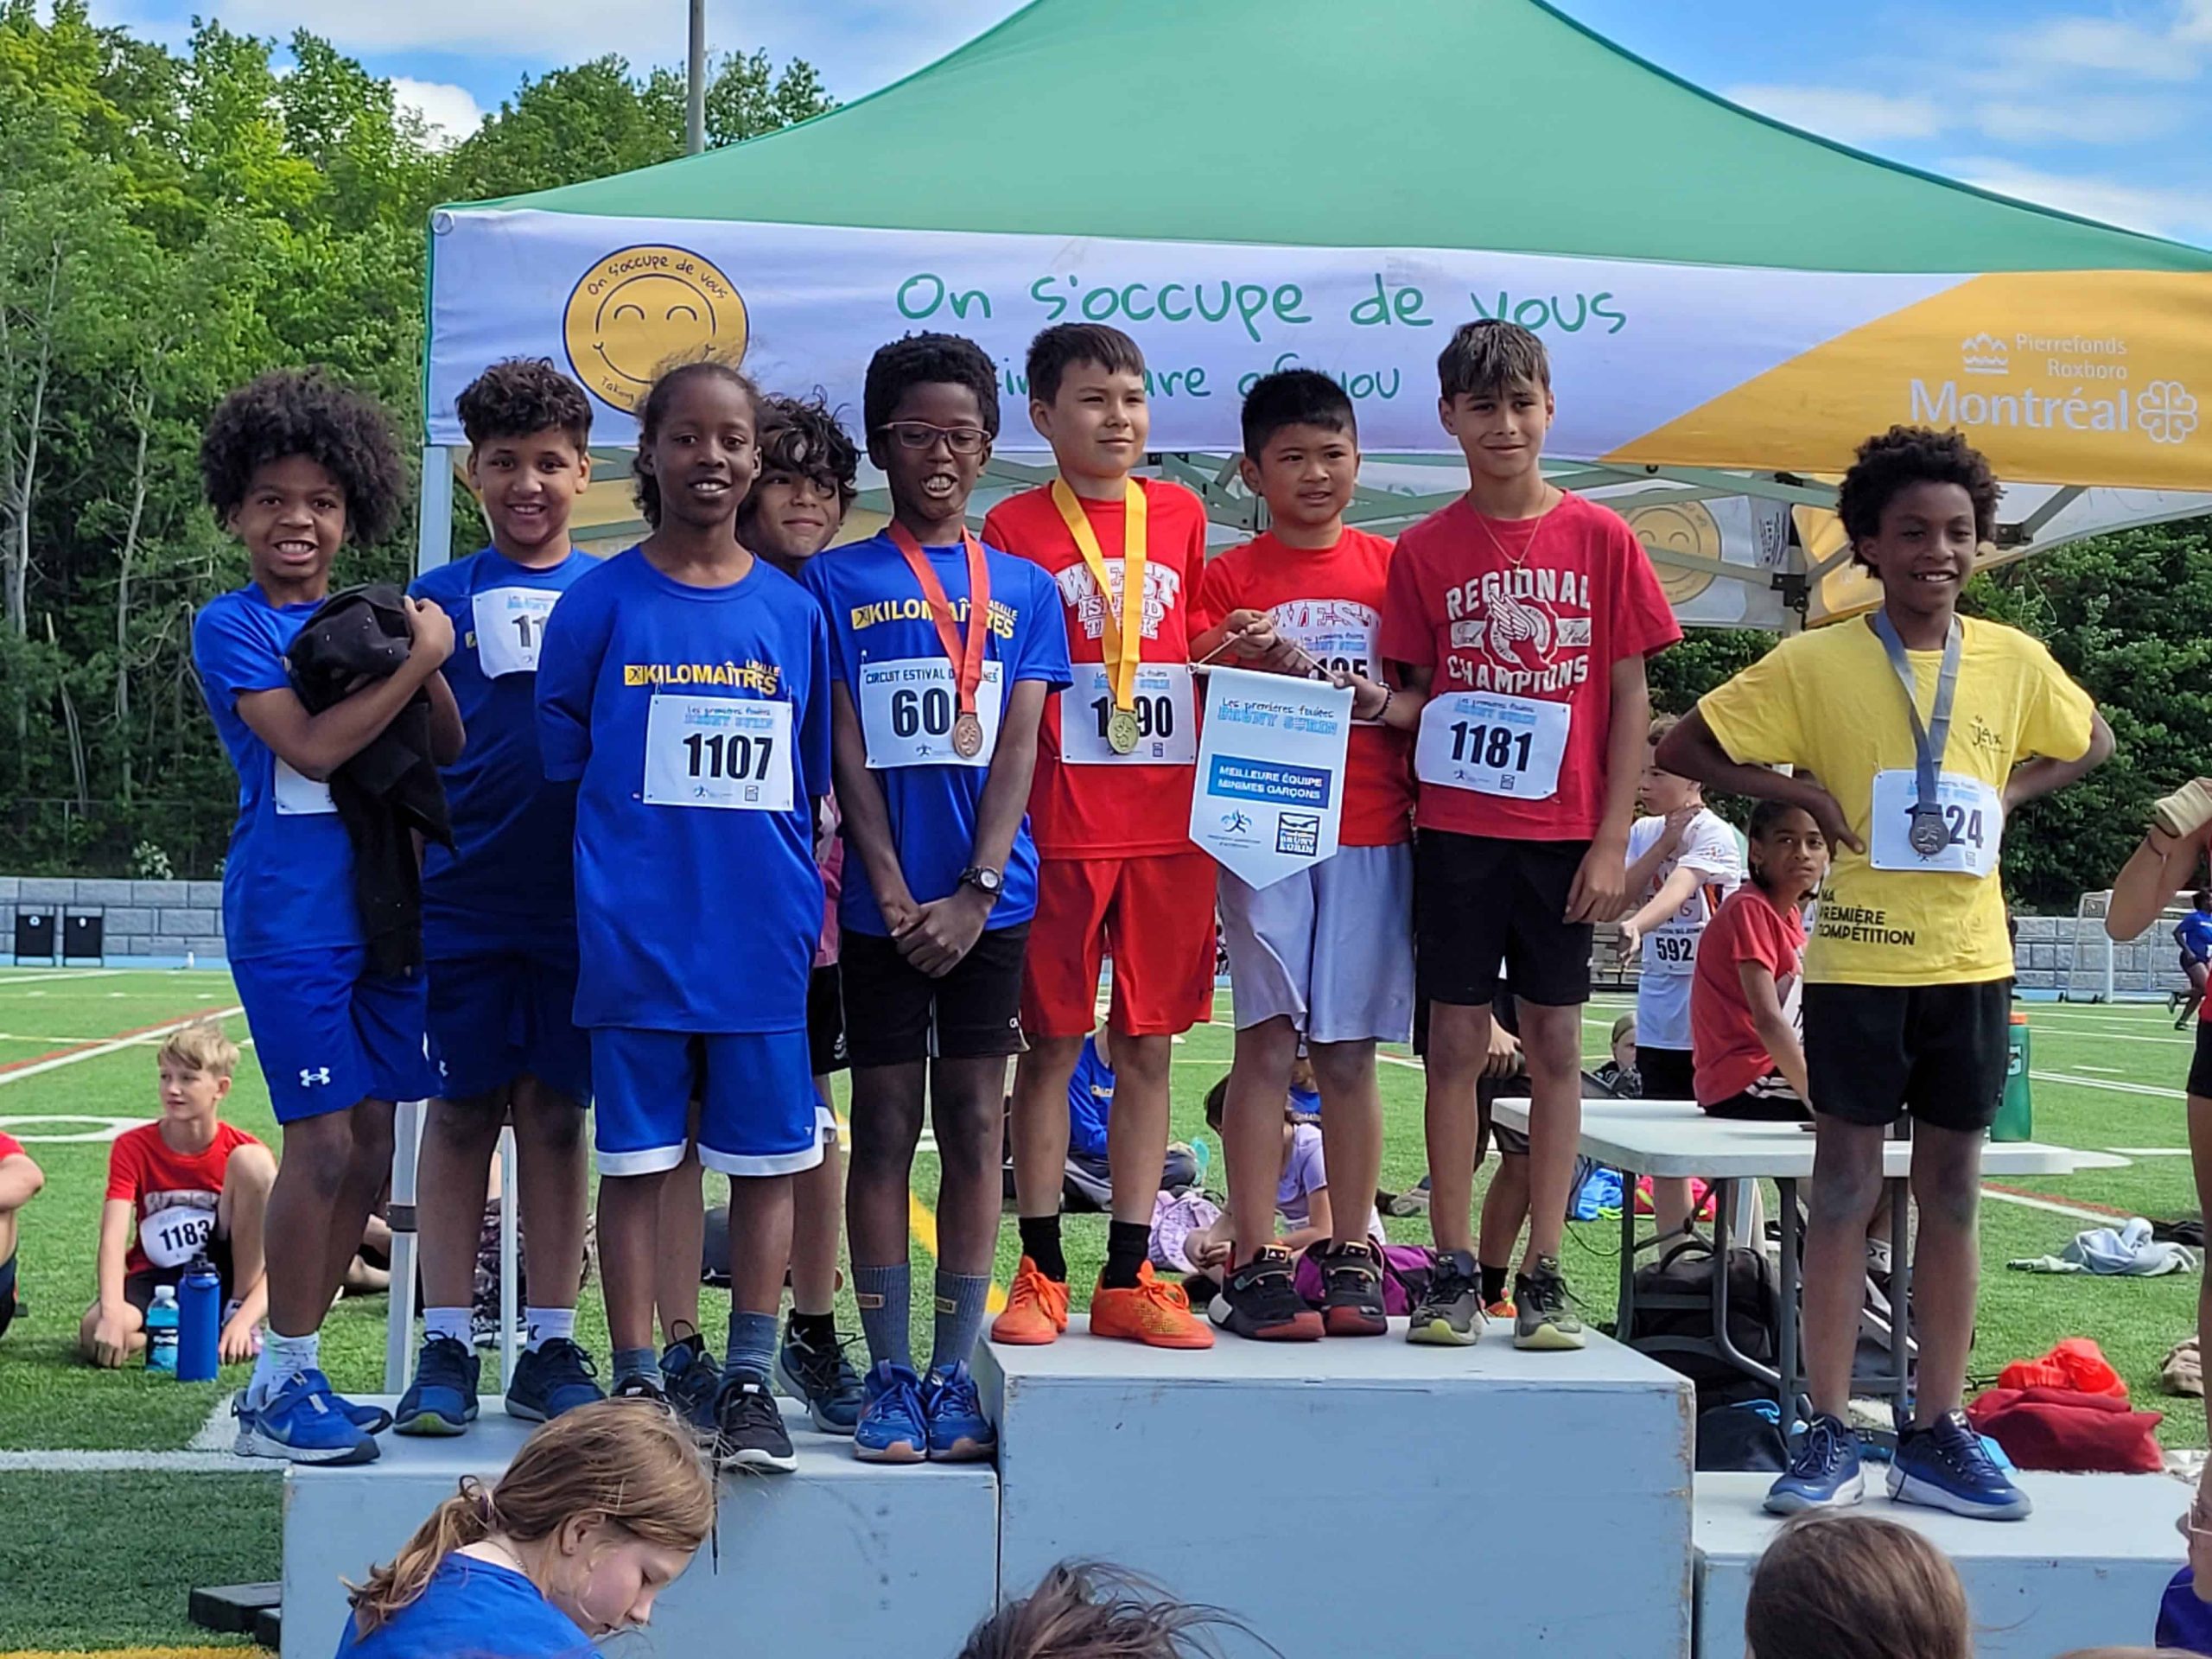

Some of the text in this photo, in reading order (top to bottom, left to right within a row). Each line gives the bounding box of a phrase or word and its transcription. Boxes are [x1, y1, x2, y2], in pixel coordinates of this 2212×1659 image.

[676, 258, 695, 275] de
[896, 273, 1627, 343] On s'occupe de vous
[2016, 333, 2127, 356] Pierrefonds
[2047, 358, 2127, 380] Roxboro
[1910, 378, 2129, 431] Montréal
[1446, 568, 1592, 621] REGIONAL
[903, 668, 945, 681] ESTIVAL
[1447, 653, 1589, 694] CHAMPIONS
[683, 734, 773, 780] 1107
[1450, 721, 1533, 772] 1181
[1219, 766, 1322, 787] MEILLEURE ÉQUIPE
[1656, 937, 1694, 961] 592
[159, 1219, 209, 1251] 1183
